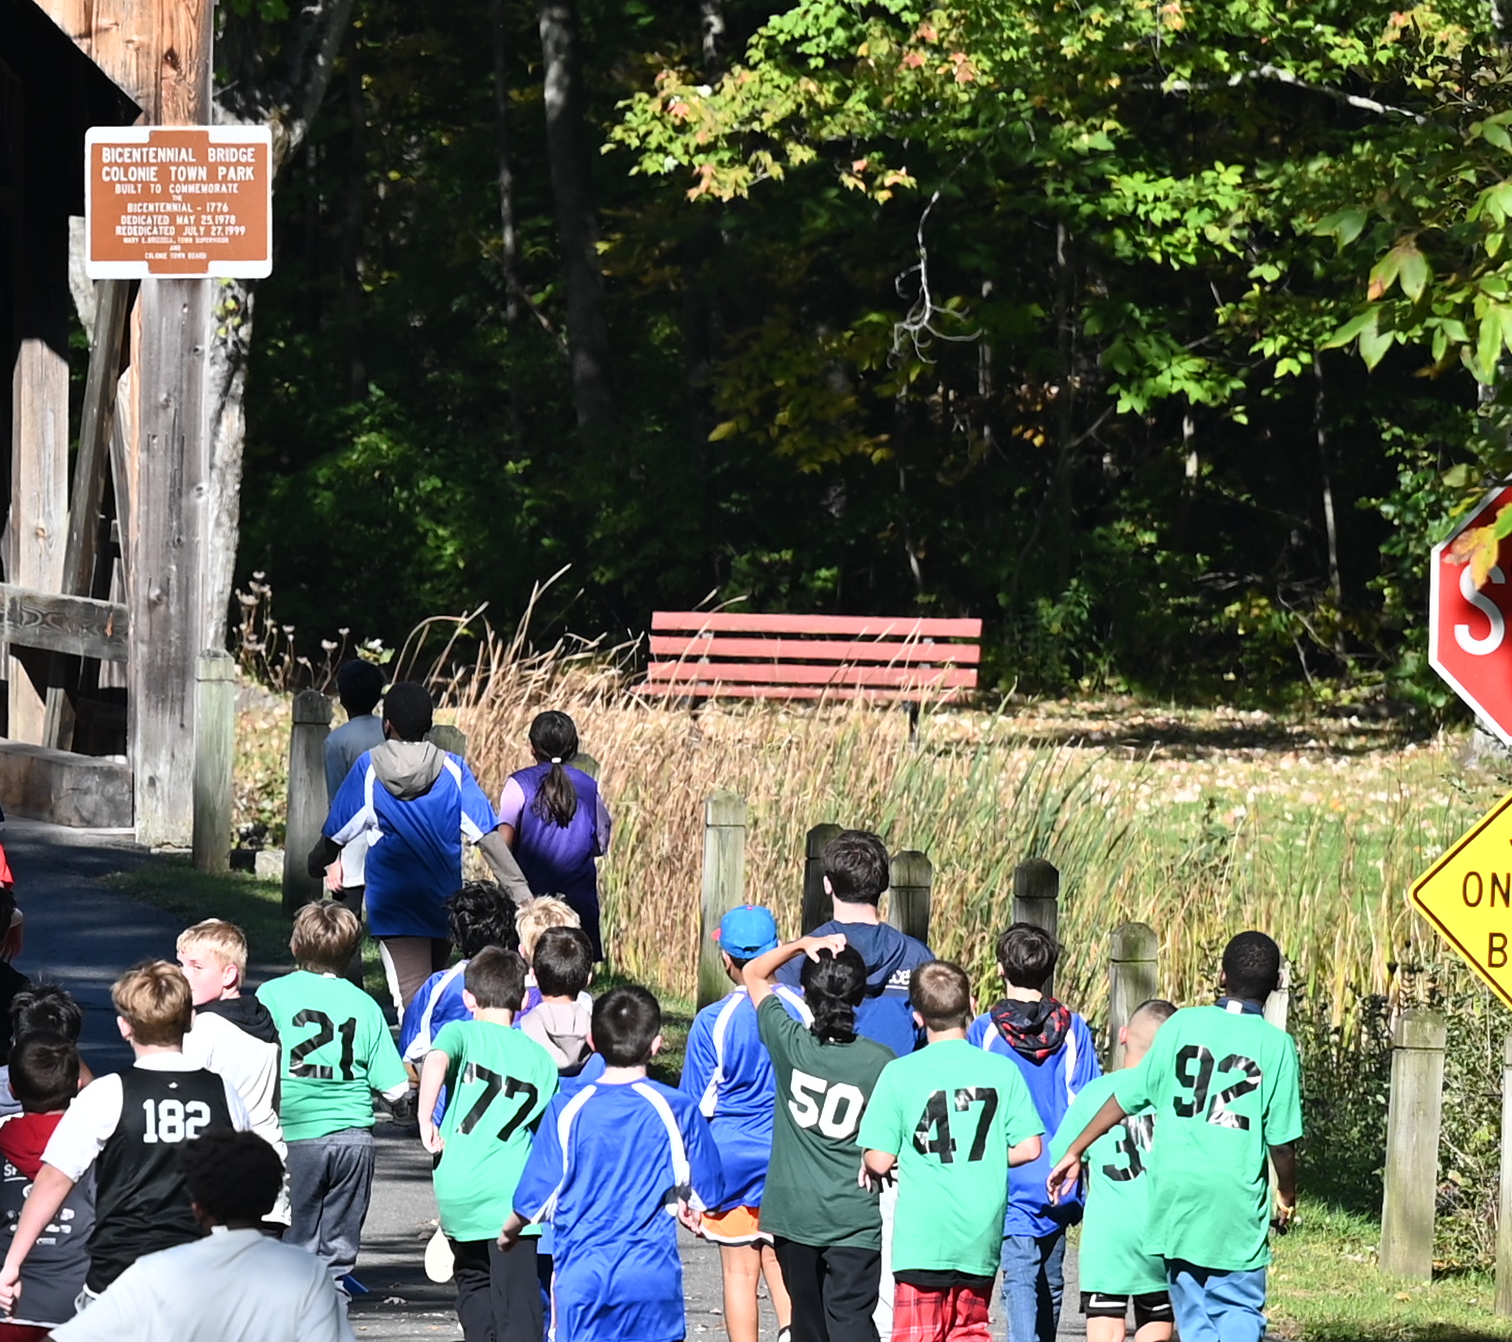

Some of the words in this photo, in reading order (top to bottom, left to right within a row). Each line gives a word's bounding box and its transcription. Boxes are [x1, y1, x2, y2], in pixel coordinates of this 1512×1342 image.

[102, 147, 196, 163] BICENTENNIAL
[208, 147, 255, 162] BRIDGE
[102, 166, 158, 182] COLONIE
[169, 166, 207, 182] TOWN
[217, 166, 254, 181] PARK
[115, 183, 142, 194] BUILT
[150, 183, 162, 194] TO
[169, 183, 239, 194] COMMEMORATE
[121, 215, 170, 225] DEDICATED
[176, 215, 195, 225] MAY
[127, 202, 193, 213] BICENTENNIAL
[206, 202, 229, 213] 1776
[115, 226, 175, 236] REDEDICATED
[182, 226, 205, 236] JULY
[289, 1008, 358, 1082] 21
[455, 1061, 538, 1143] 77
[787, 1066, 864, 1139] 50
[1173, 1044, 1263, 1131] 92
[142, 1099, 212, 1144] 182
[912, 1086, 999, 1165] 47
